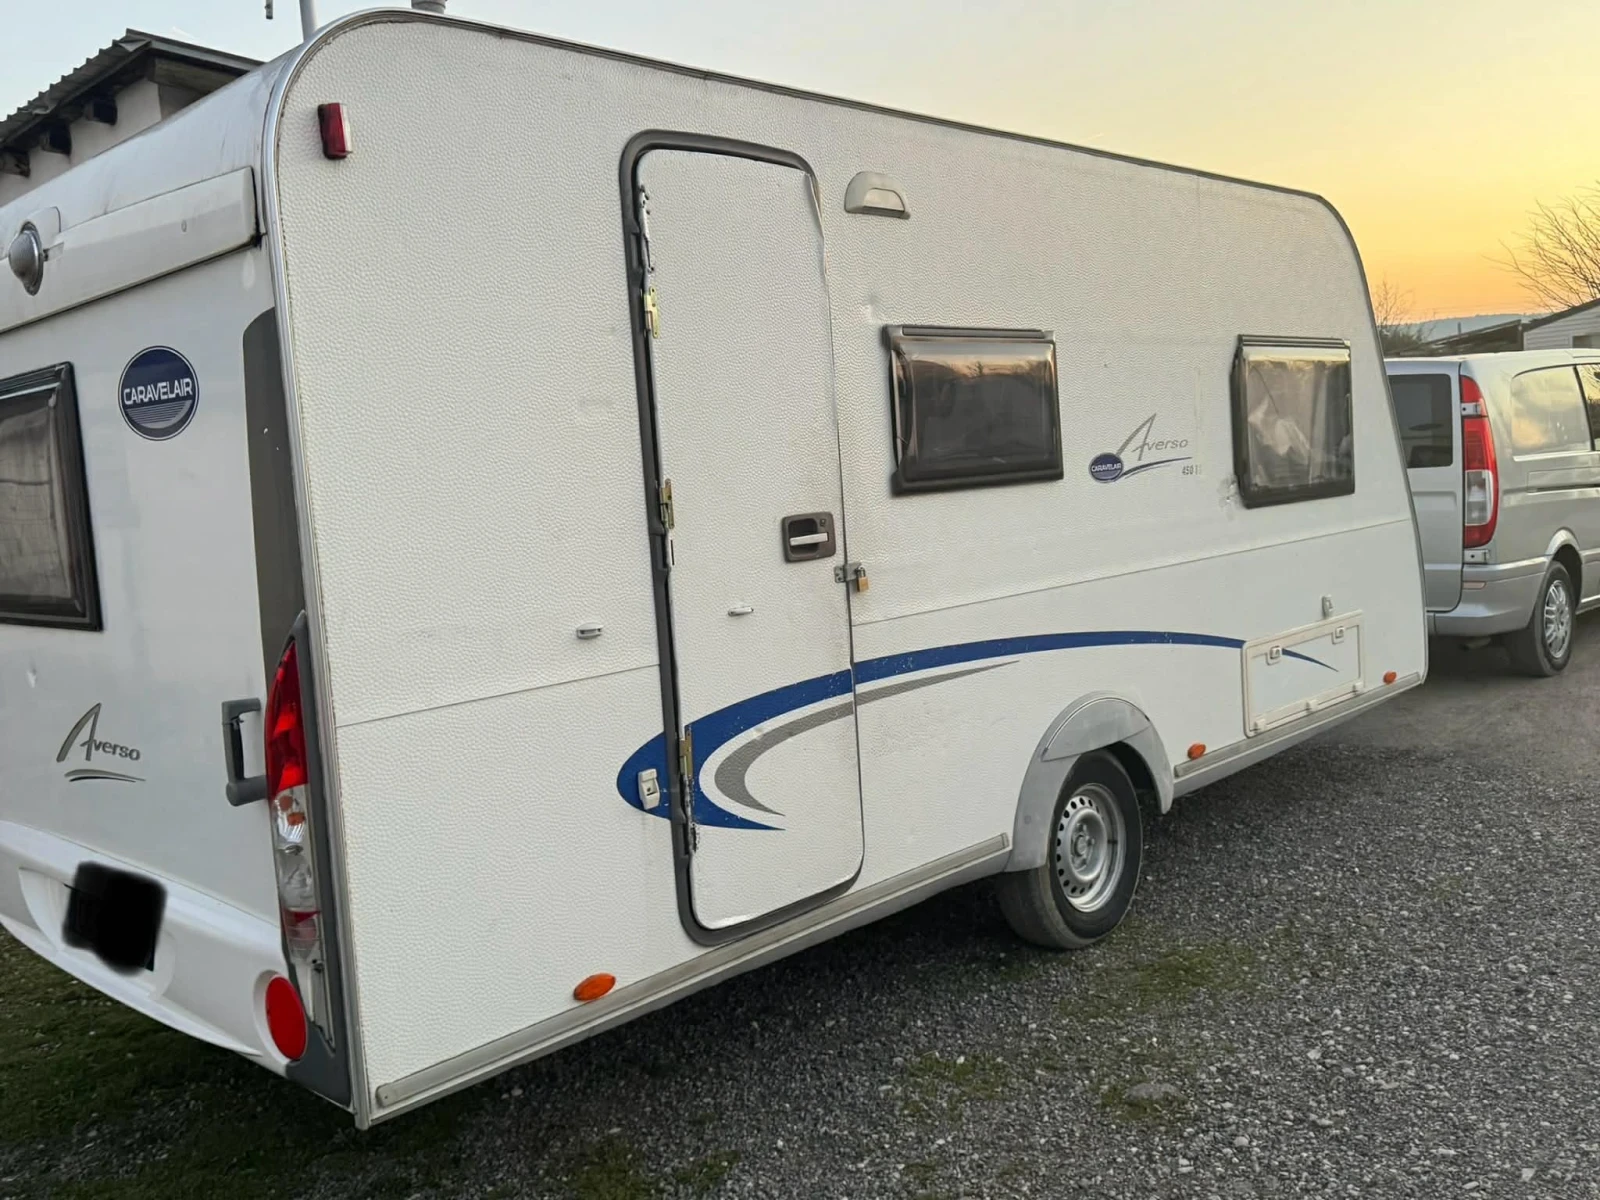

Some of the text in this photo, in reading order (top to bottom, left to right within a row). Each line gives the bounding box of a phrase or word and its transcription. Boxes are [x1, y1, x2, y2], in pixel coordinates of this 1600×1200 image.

[123, 378, 193, 405] CARAVELAIR
[1116, 412, 1188, 461] Averso
[1091, 462, 1122, 472] CARAVELAIR
[56, 702, 141, 763] Averso
